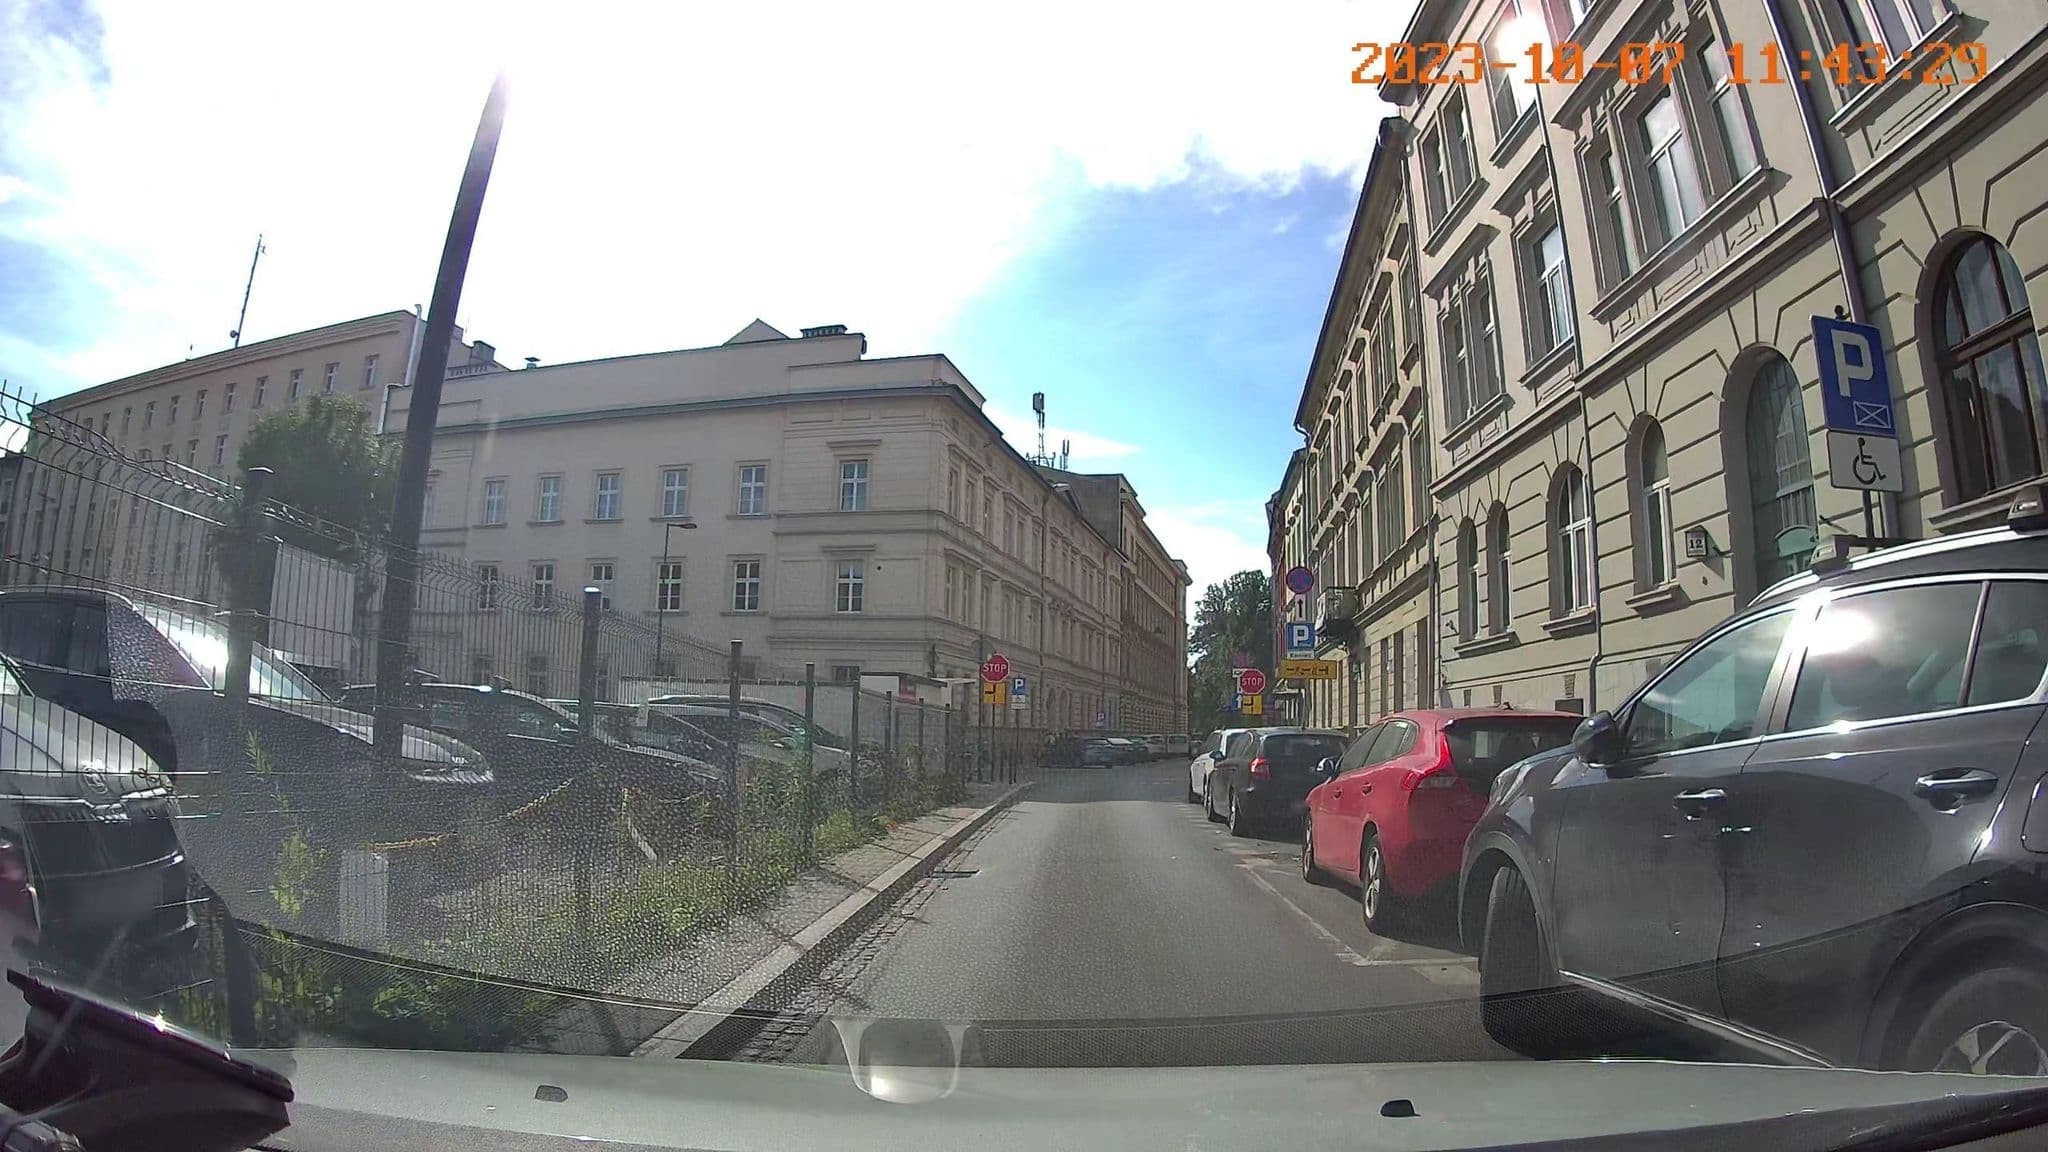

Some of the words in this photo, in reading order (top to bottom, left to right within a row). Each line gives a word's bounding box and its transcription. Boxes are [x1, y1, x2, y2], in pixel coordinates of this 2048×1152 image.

[1830, 328, 1875, 398] P
[1689, 538, 1704, 549] 12
[1292, 624, 1310, 648] P
[983, 662, 1007, 673] STOP
[1014, 678, 1024, 690] P
[1241, 677, 1263, 687] STOP
